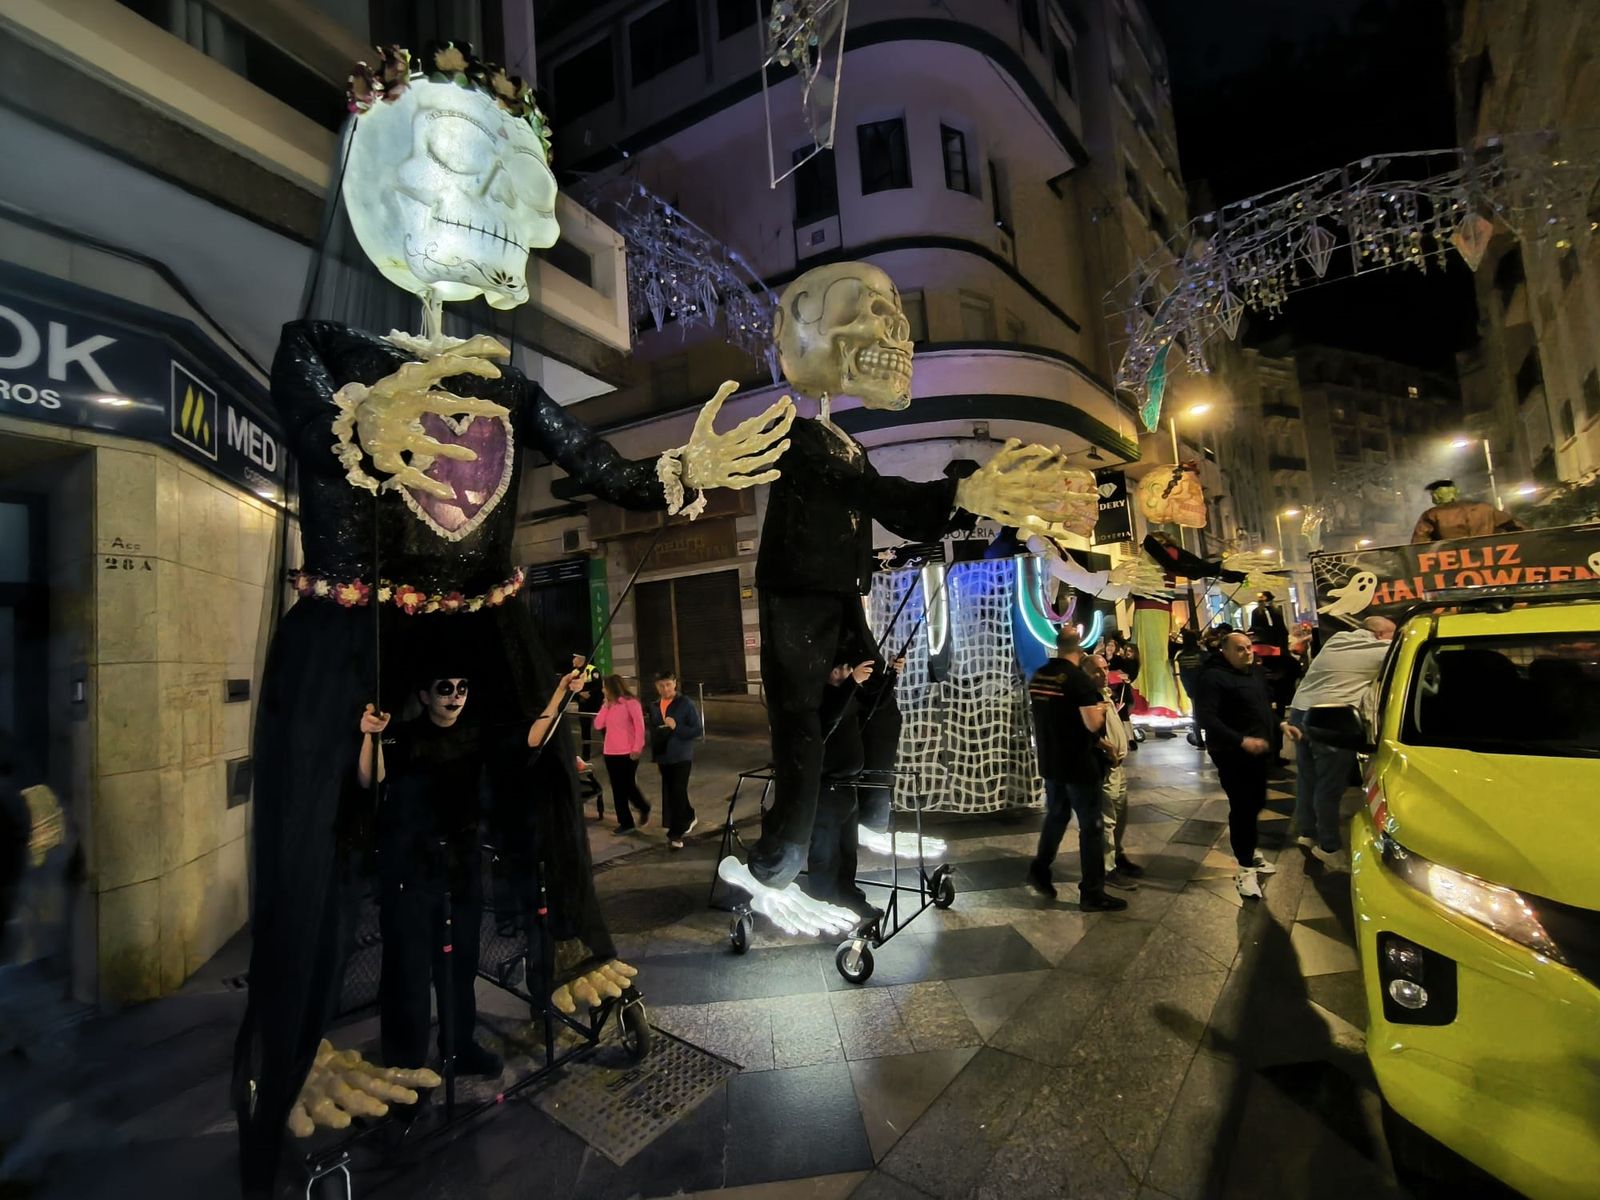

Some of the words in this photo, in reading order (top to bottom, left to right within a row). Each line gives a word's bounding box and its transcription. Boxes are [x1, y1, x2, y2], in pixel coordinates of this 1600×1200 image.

[227, 405, 277, 472] MED
[1099, 499, 1126, 511] DERY
[1418, 544, 1521, 573] FELIZ
